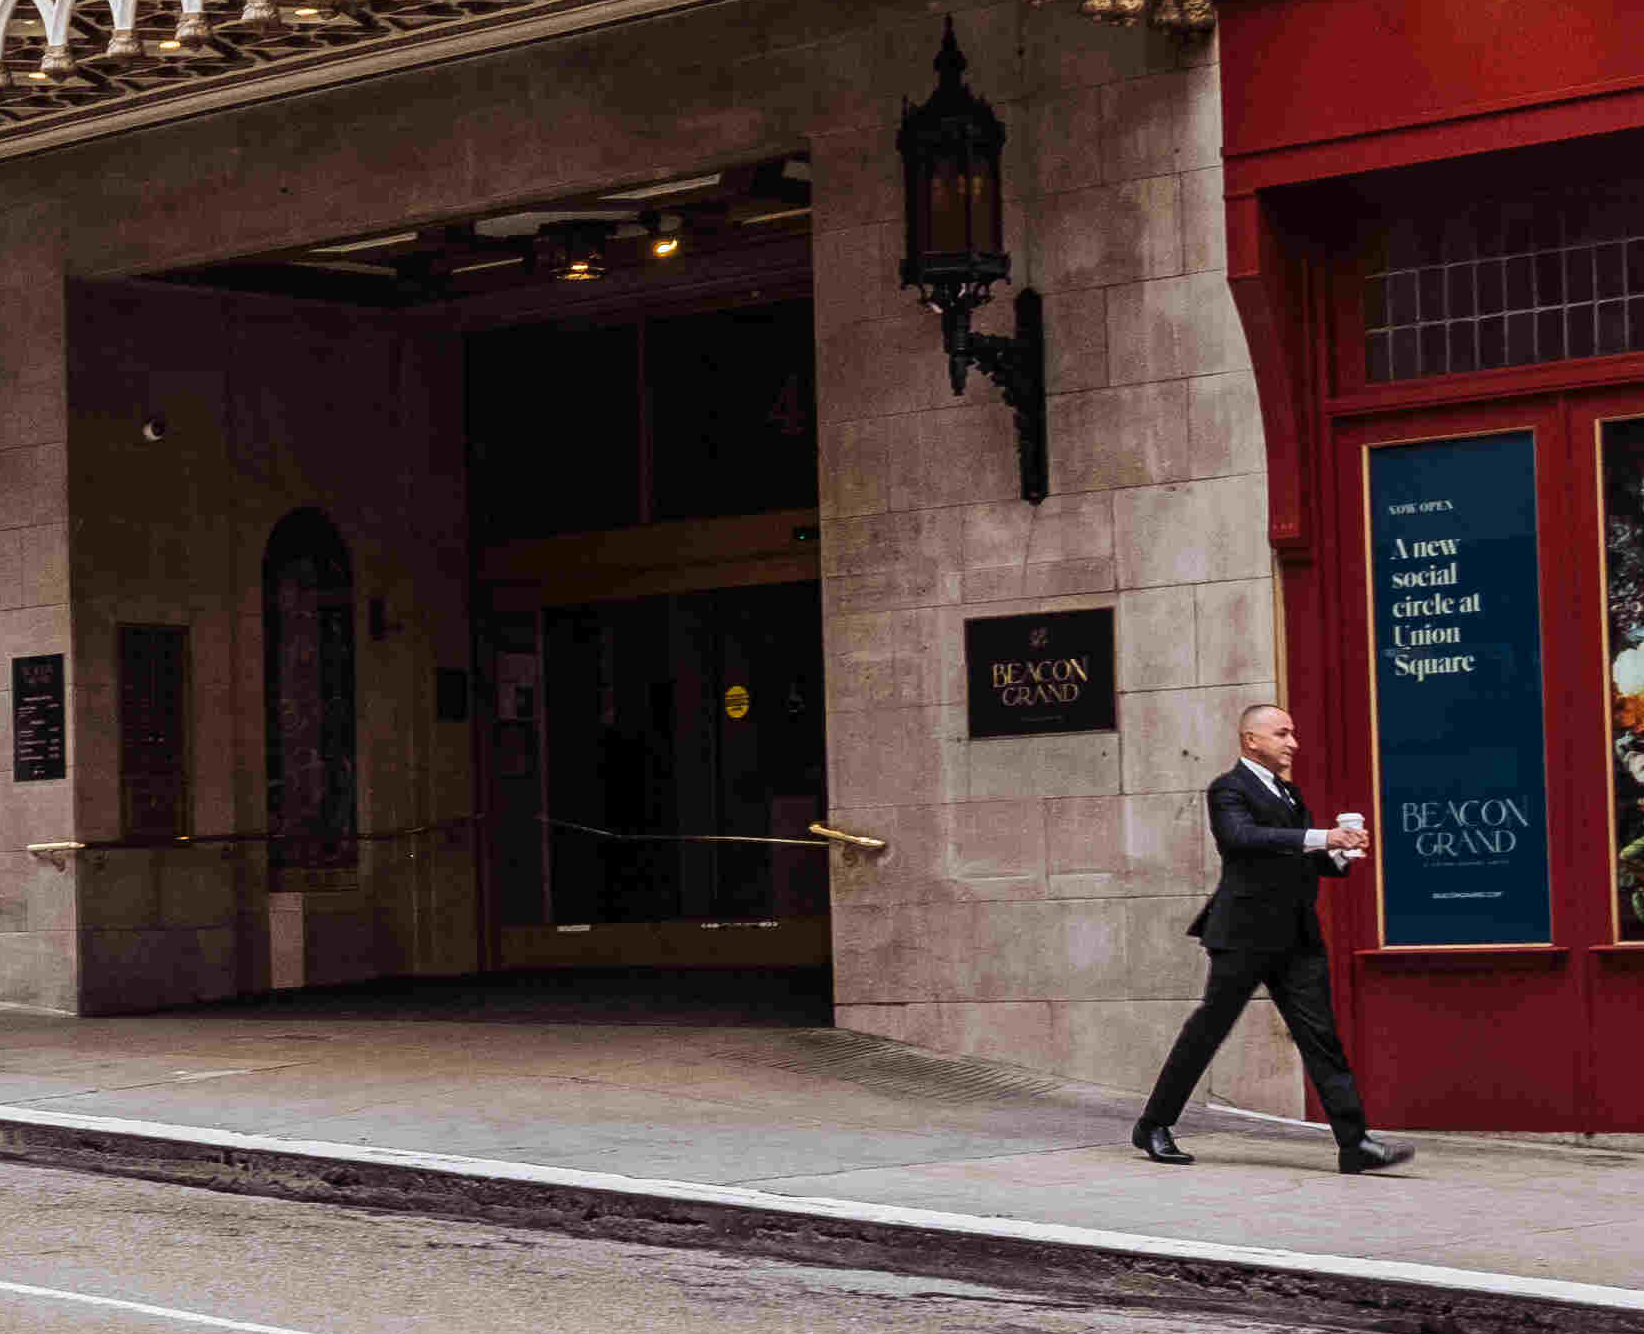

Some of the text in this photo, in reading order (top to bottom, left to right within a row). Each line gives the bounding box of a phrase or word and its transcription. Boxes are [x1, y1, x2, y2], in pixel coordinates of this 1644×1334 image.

[1389, 538, 1461, 560] A new
[1391, 562, 1457, 589] social
[1392, 593, 1481, 618] circle at
[1393, 623, 1461, 650] Union
[991, 657, 1089, 688] BEACON
[1394, 653, 1476, 683] Square
[1002, 683, 1080, 707] GRAND
[1402, 798, 1529, 832] BEACON
[1416, 829, 1516, 856] GRAND
